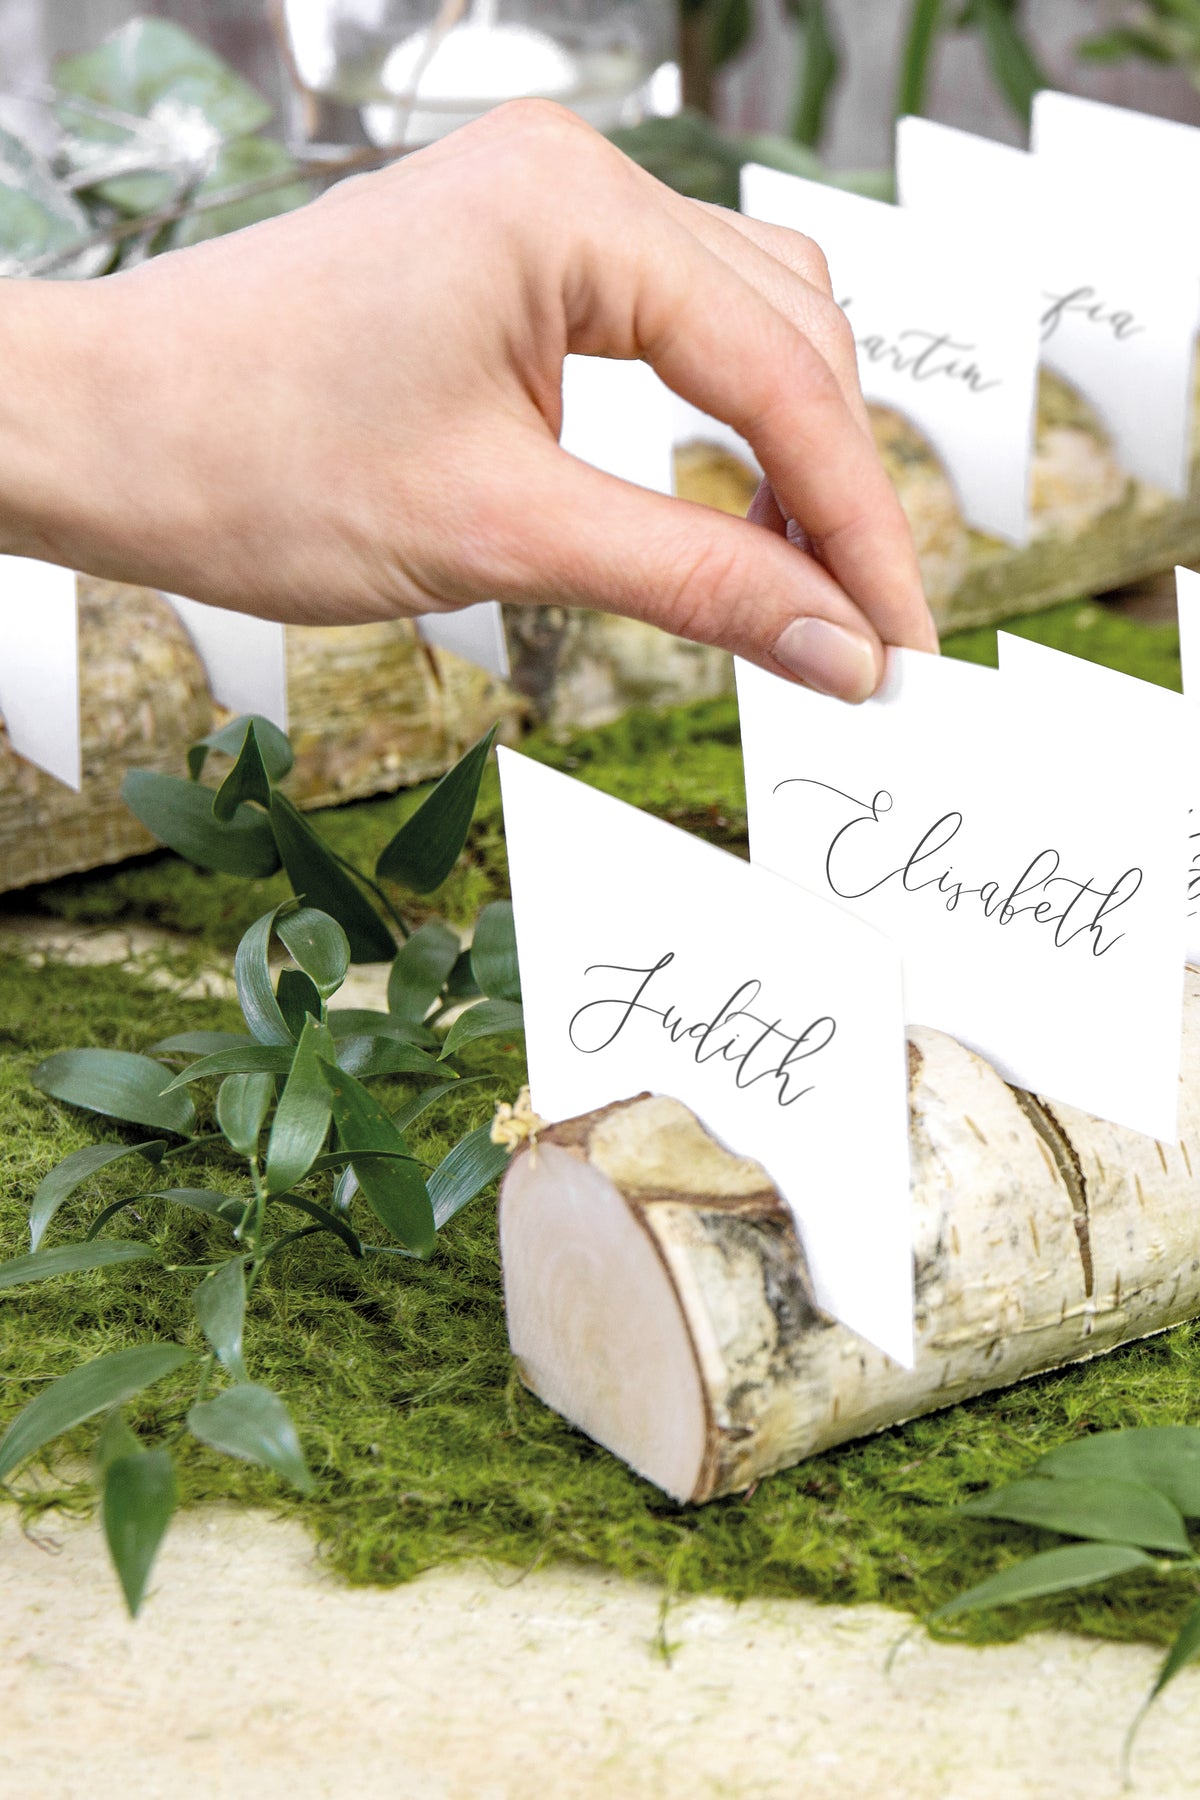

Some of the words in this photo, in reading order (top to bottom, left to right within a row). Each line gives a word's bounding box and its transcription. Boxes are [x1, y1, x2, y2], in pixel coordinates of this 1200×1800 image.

[848, 314, 1003, 392] artin
[773, 779, 1143, 957] Elisabeth
[568, 951, 837, 1107] Judith
